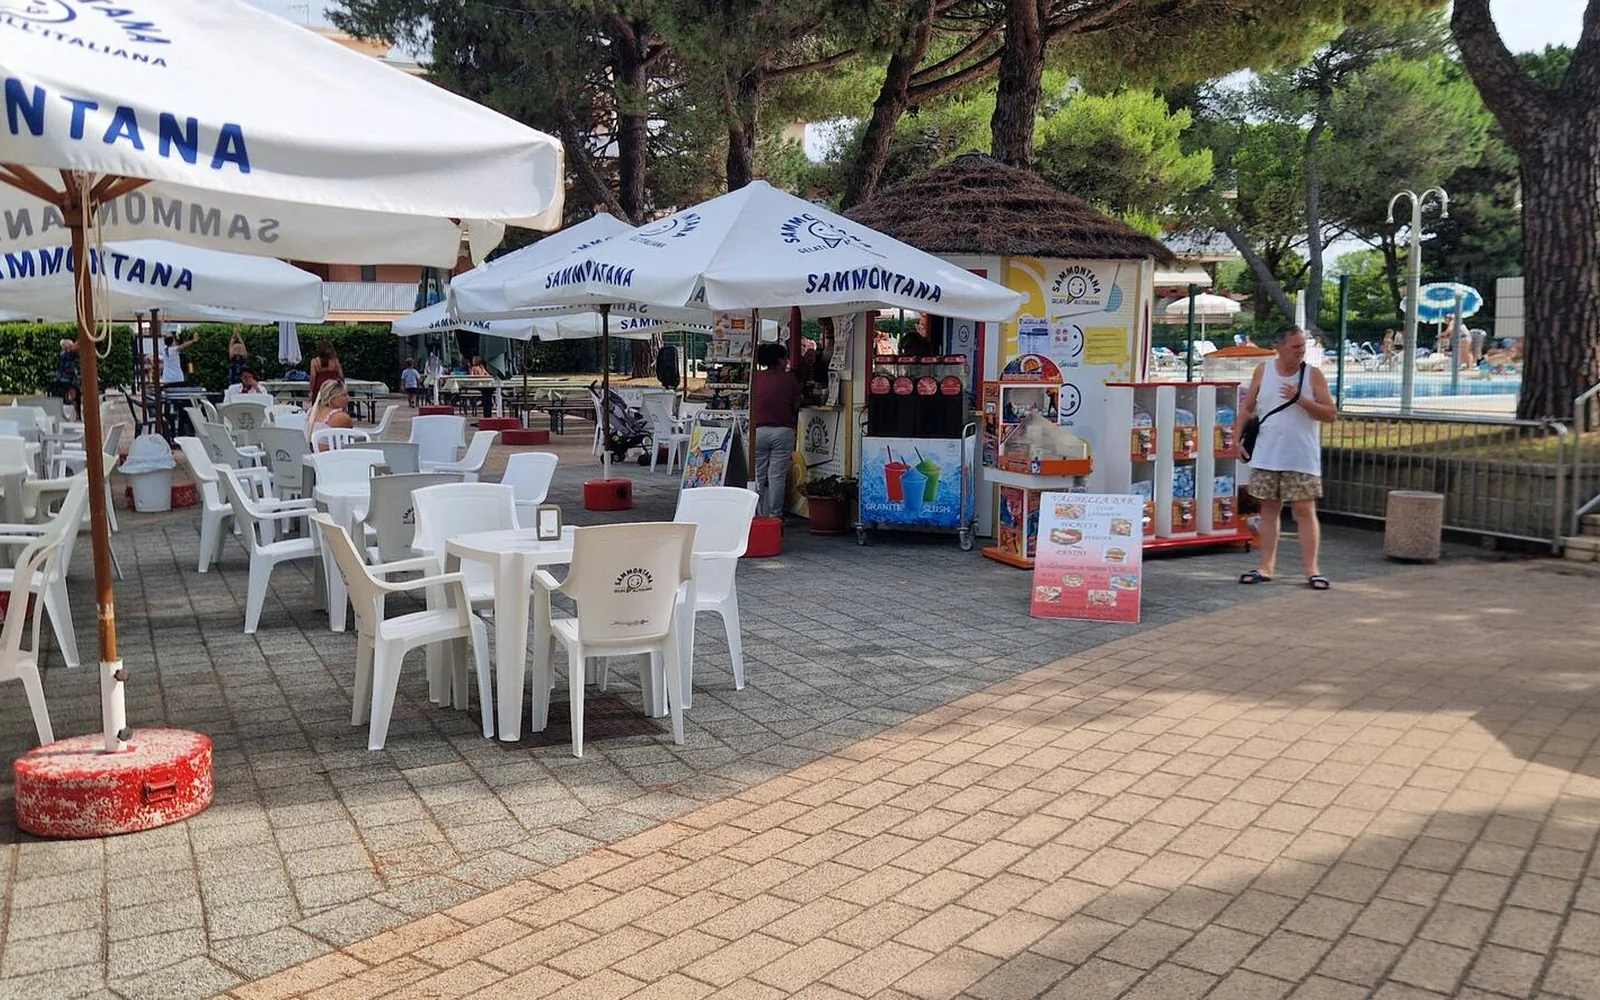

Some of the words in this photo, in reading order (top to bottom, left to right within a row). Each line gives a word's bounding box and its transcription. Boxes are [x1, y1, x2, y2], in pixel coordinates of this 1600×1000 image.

[0, 16, 168, 68] LL'ITALIANA
[545, 258, 635, 290] SAMMONTANA
[805, 266, 943, 303] SAMMONTANA
[1051, 265, 1101, 295] SAMMONTANA
[614, 567, 653, 585] SAMMONTANA
